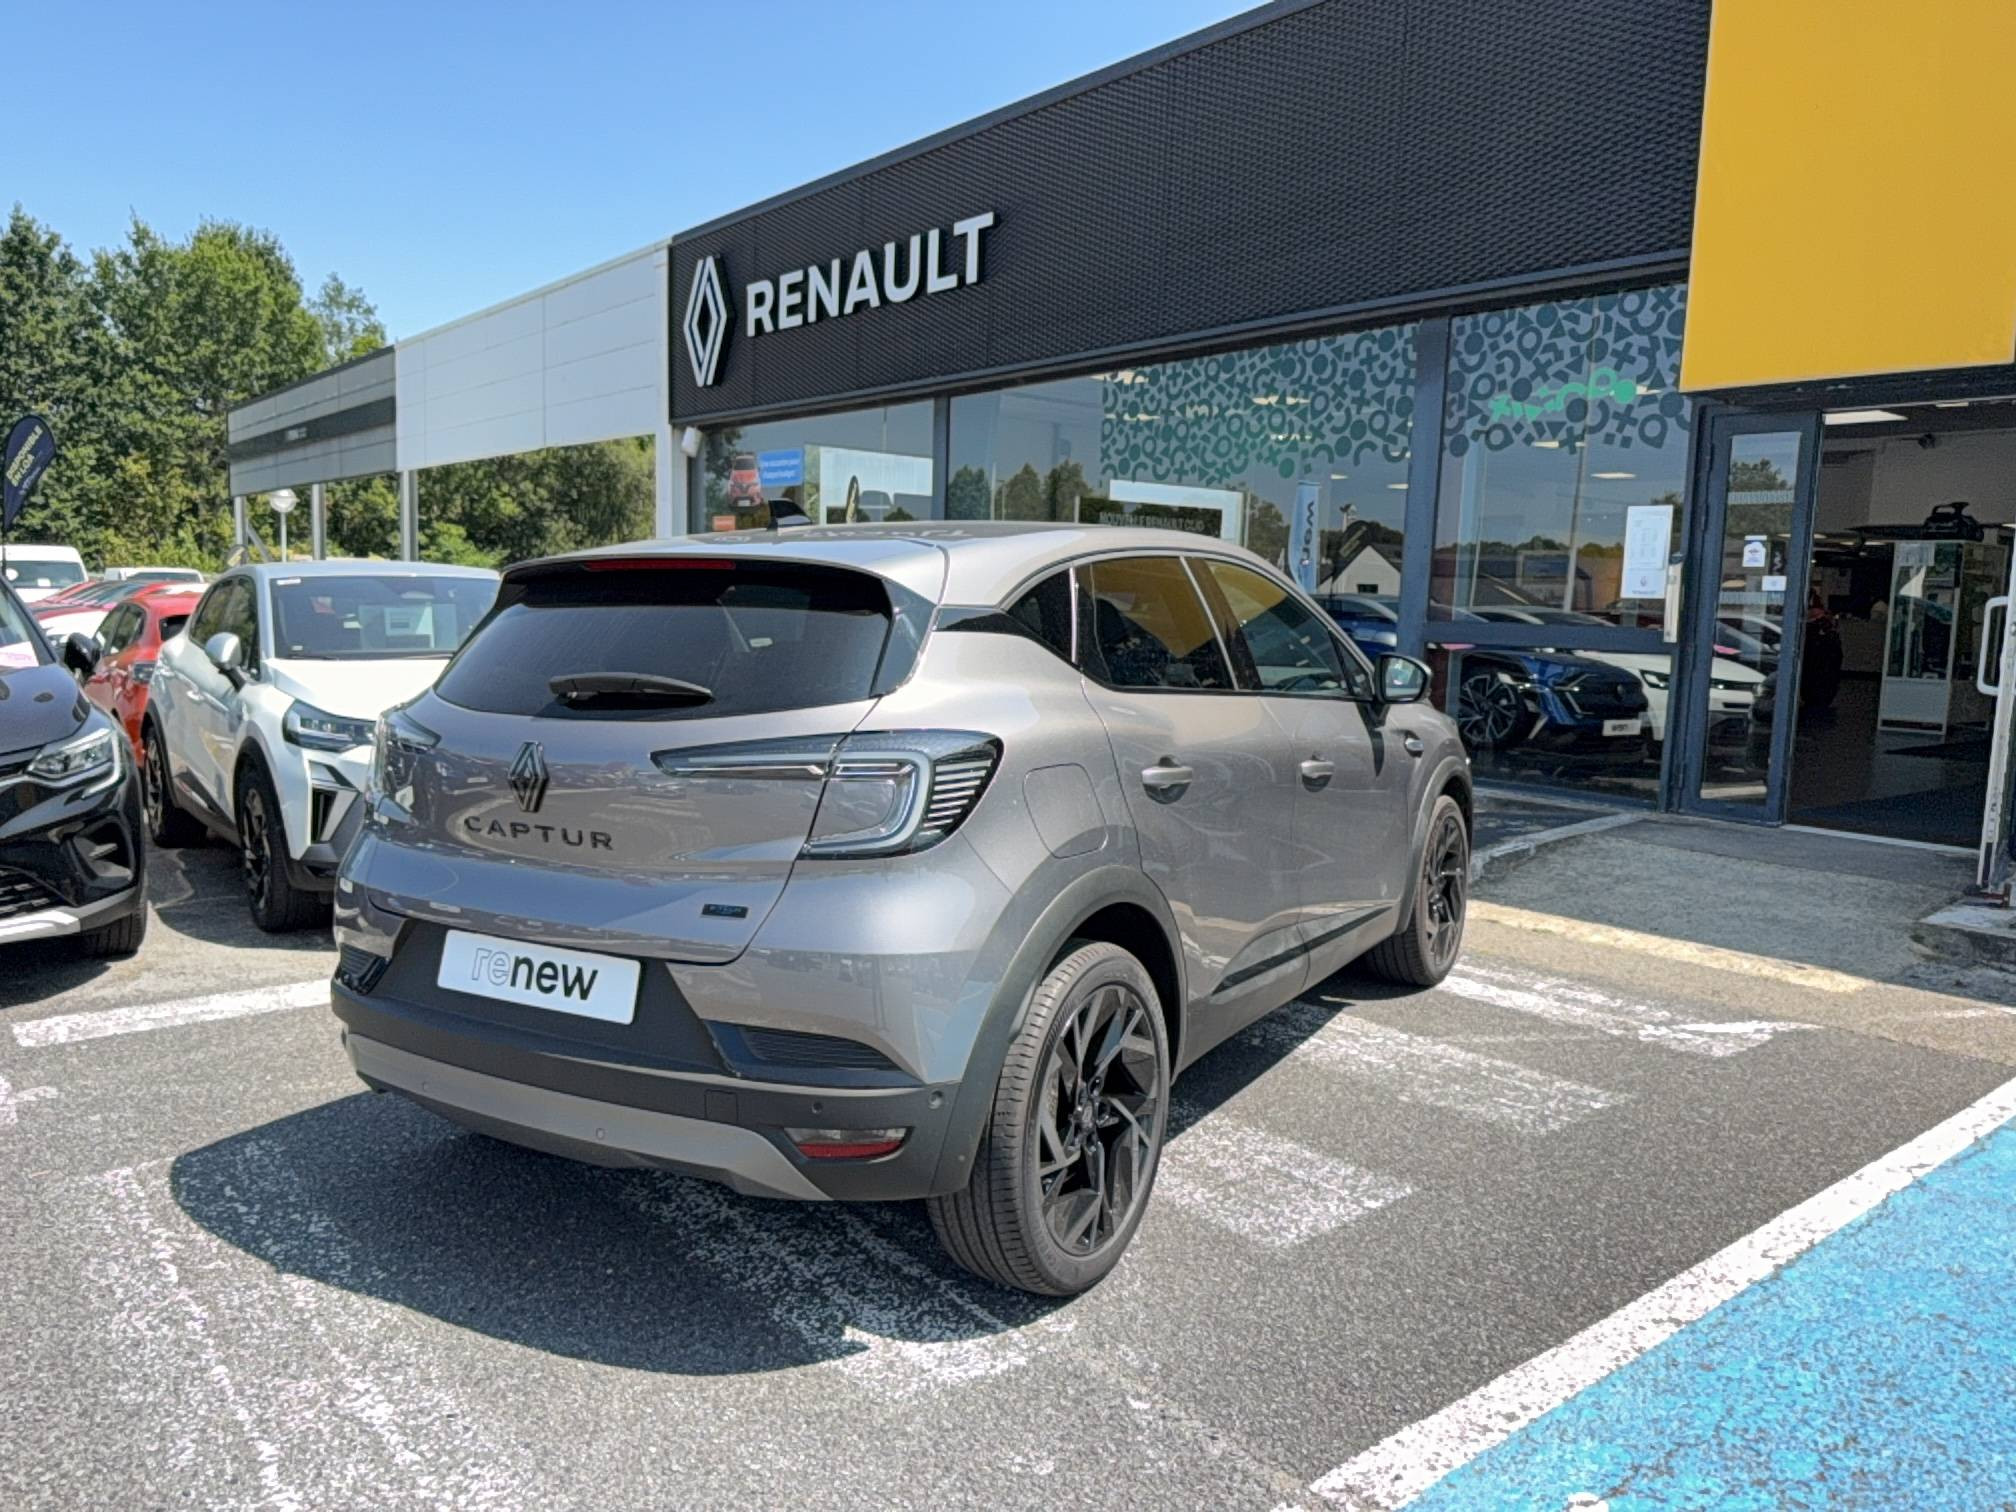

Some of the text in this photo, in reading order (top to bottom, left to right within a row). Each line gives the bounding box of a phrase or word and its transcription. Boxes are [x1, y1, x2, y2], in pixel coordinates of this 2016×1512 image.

[746, 211, 995, 337] RENAULT
[464, 815, 613, 851] CAPTUR
[471, 947, 598, 1001] renew
